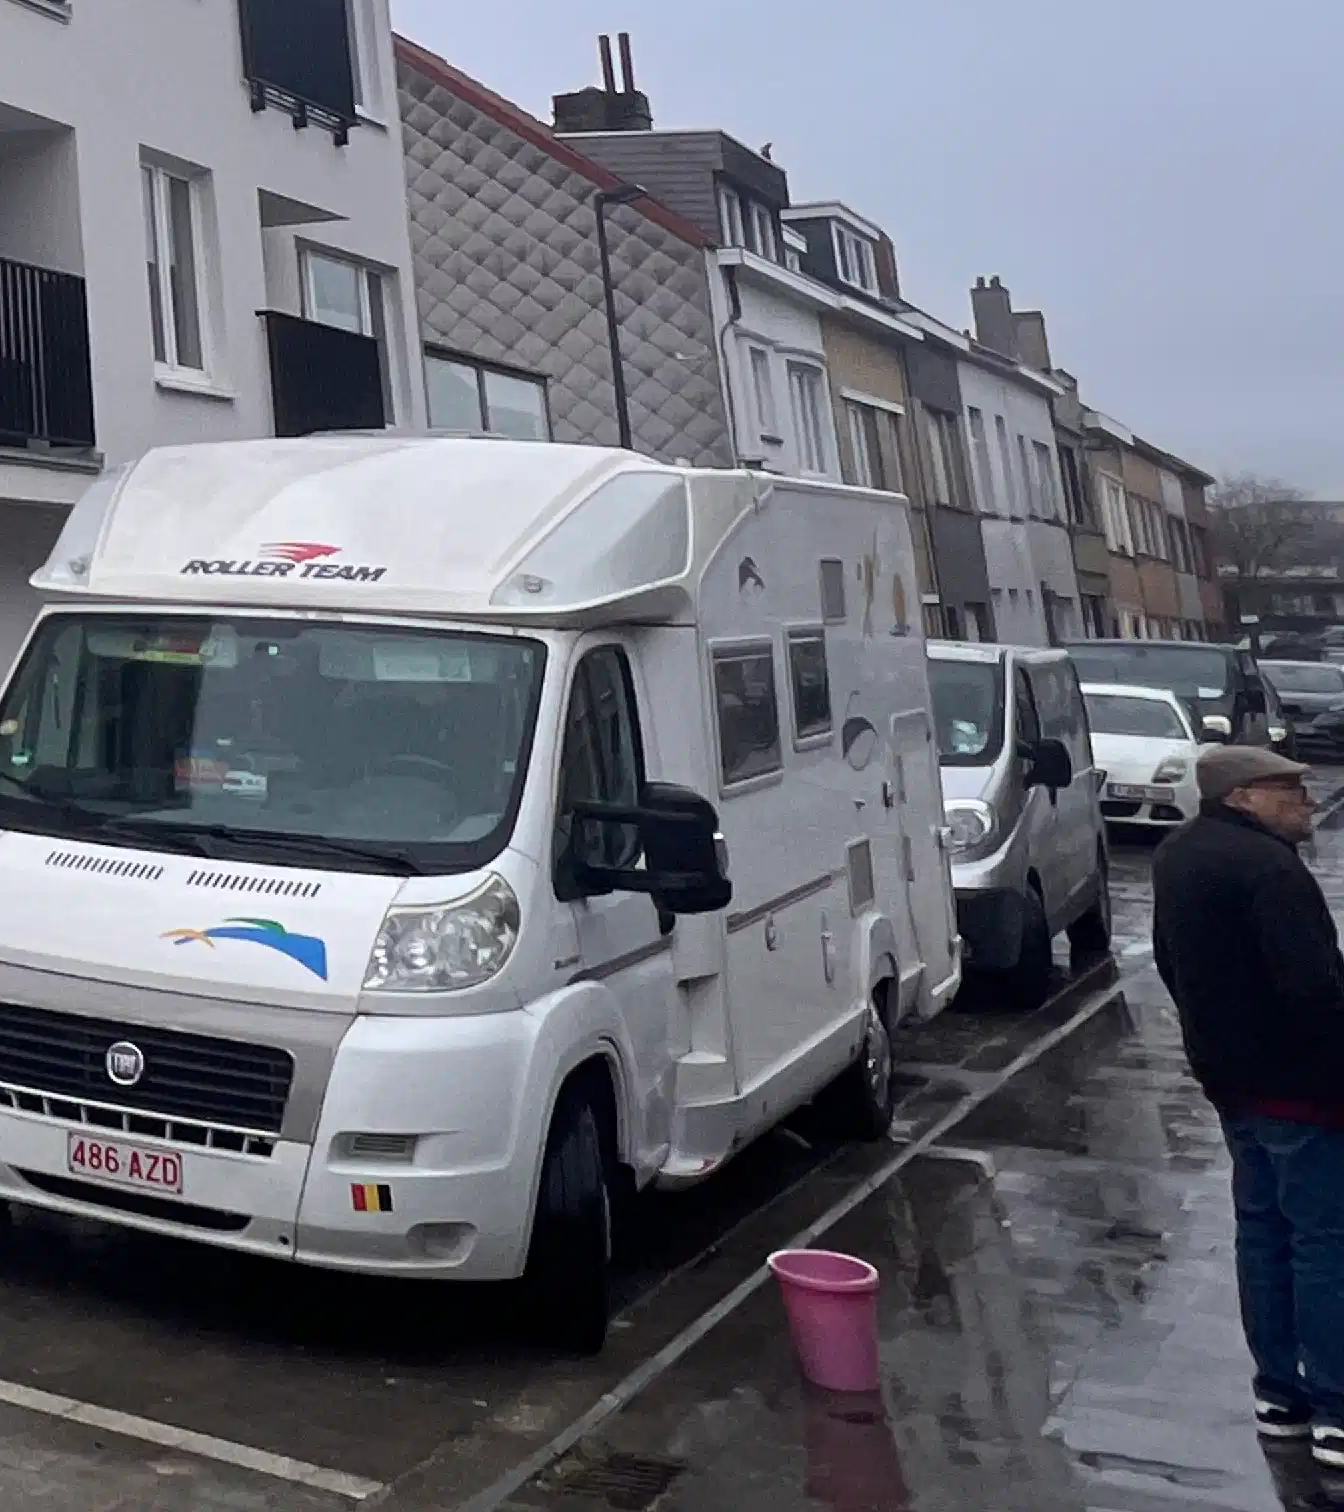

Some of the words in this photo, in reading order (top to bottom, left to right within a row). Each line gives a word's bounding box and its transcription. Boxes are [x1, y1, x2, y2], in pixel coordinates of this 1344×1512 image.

[180, 559, 295, 577] ROLLER
[300, 562, 387, 582] TEAM
[72, 1141, 119, 1172] 486
[129, 1151, 178, 1185] AZD
